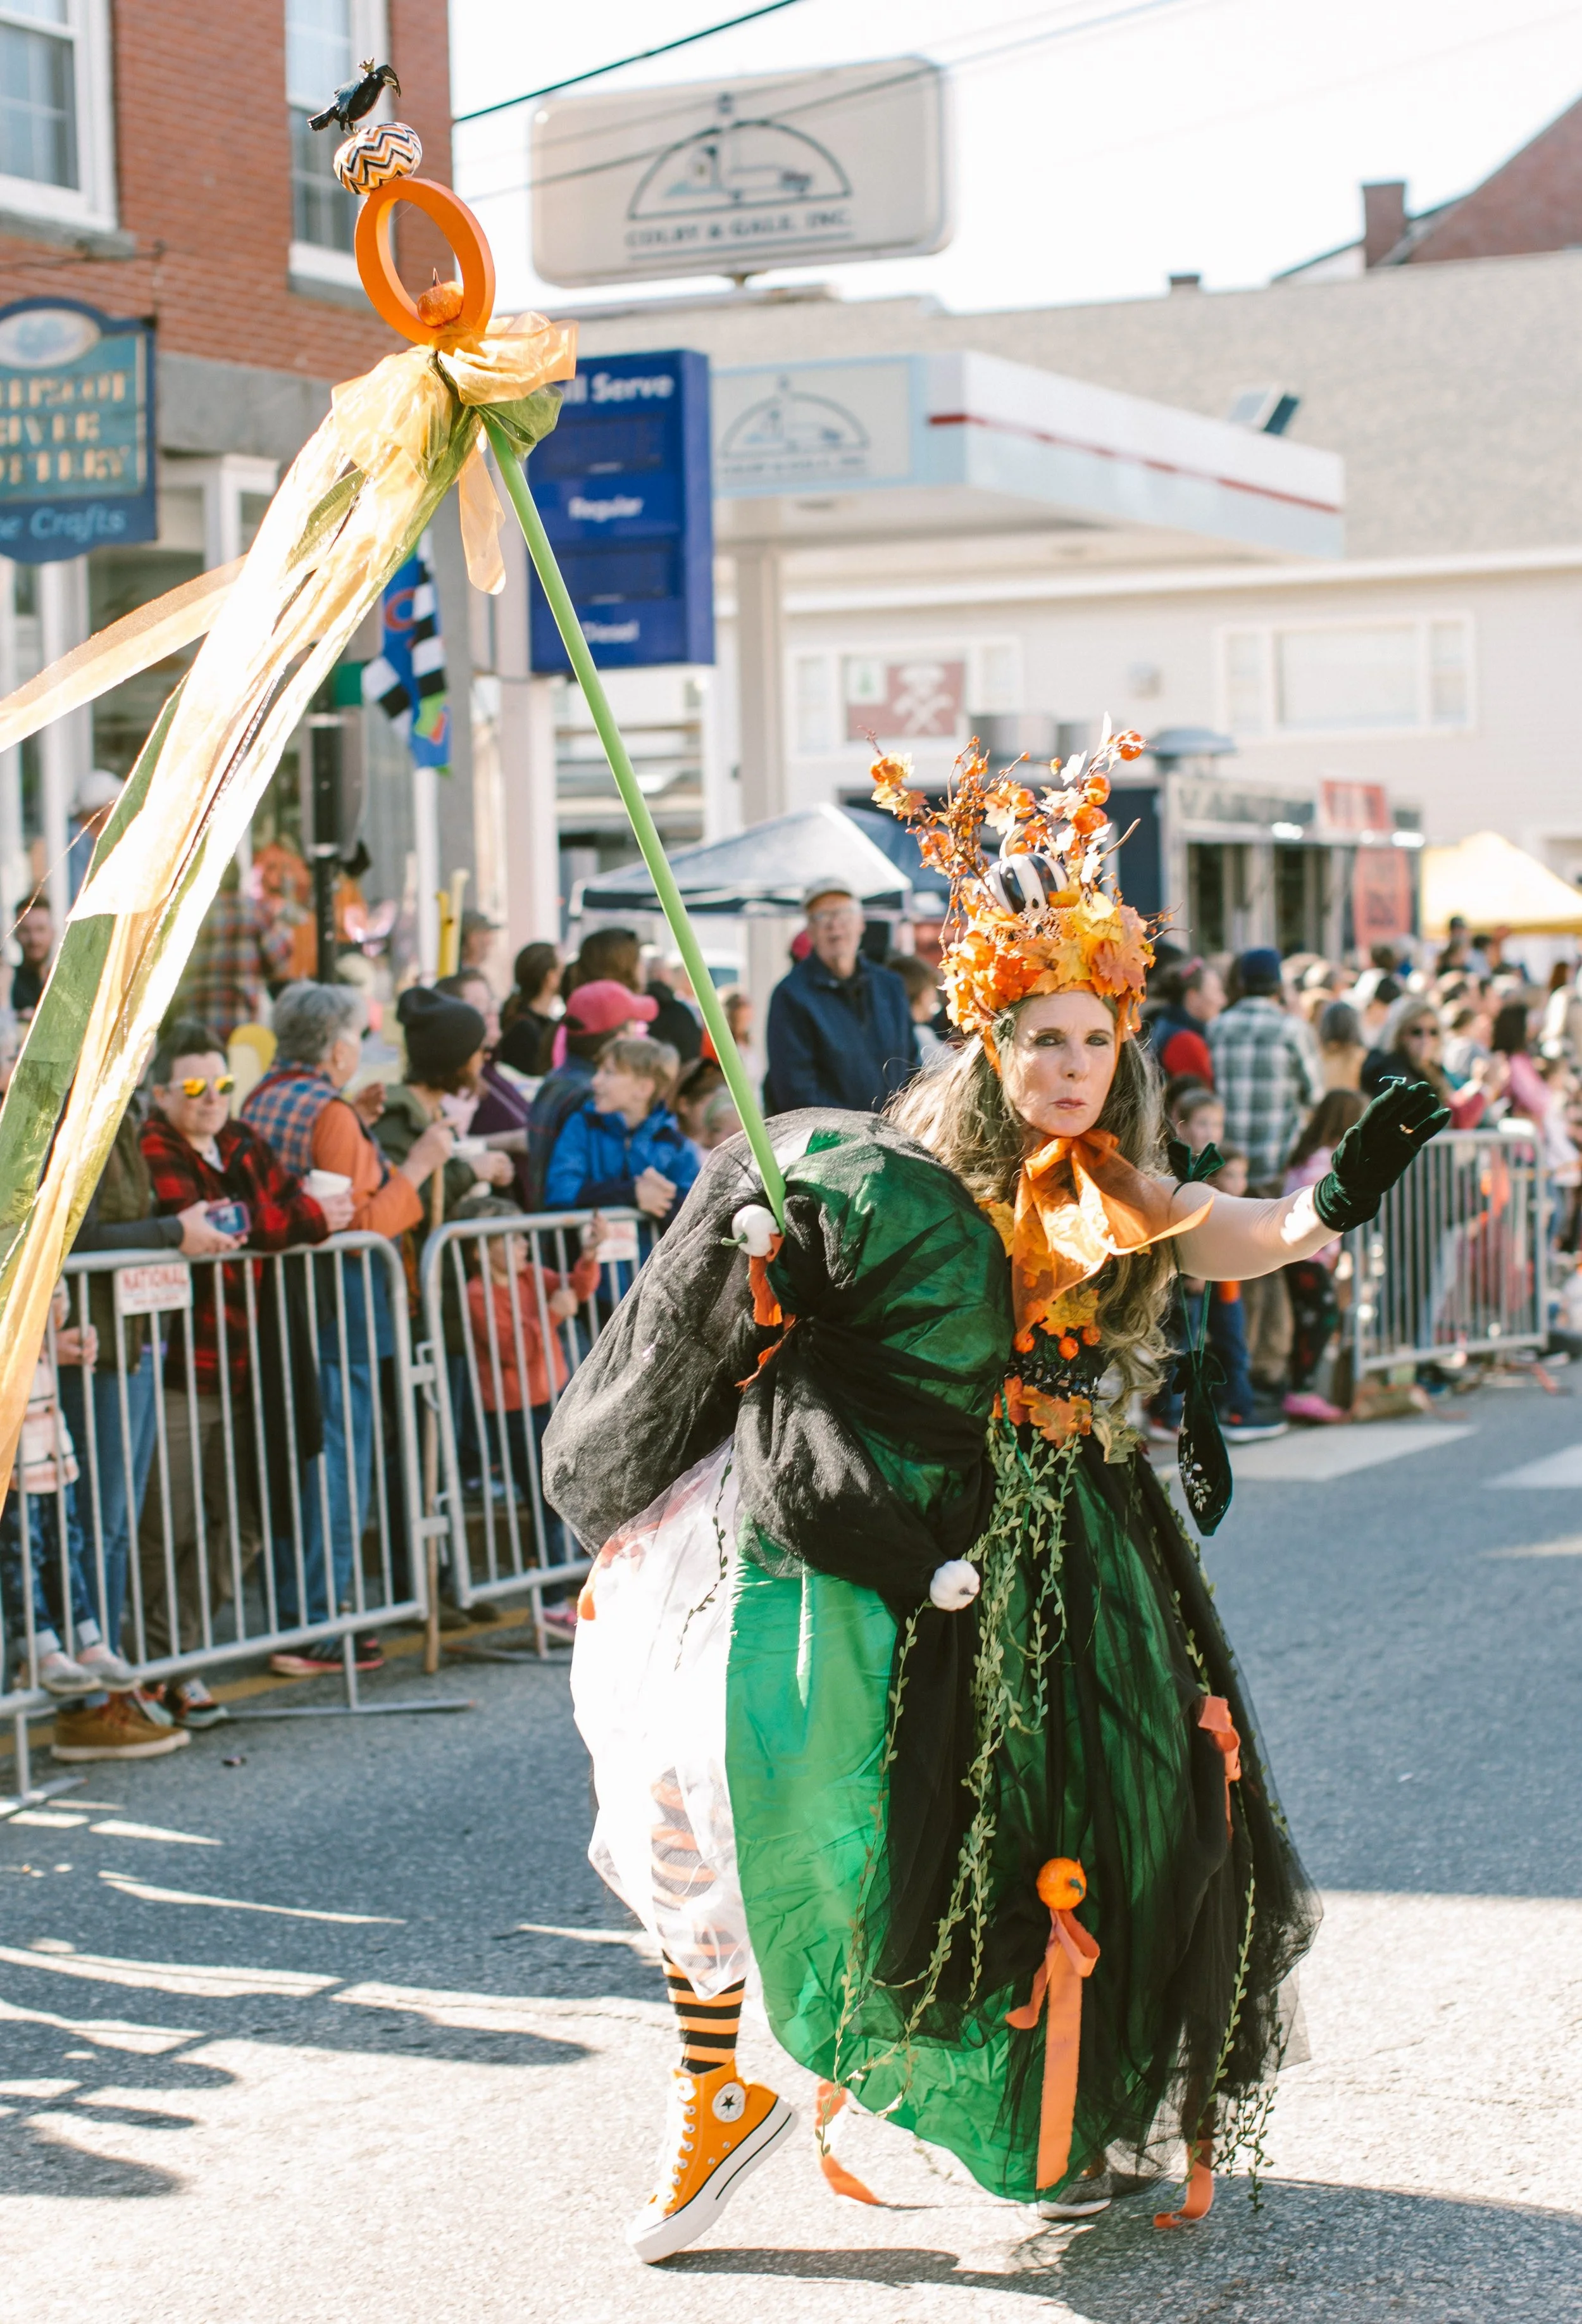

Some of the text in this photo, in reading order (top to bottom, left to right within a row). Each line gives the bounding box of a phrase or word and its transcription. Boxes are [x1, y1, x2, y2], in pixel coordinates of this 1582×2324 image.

[592, 372, 675, 403] Serve
[30, 504, 126, 543] Crafts
[569, 496, 644, 523] Regular
